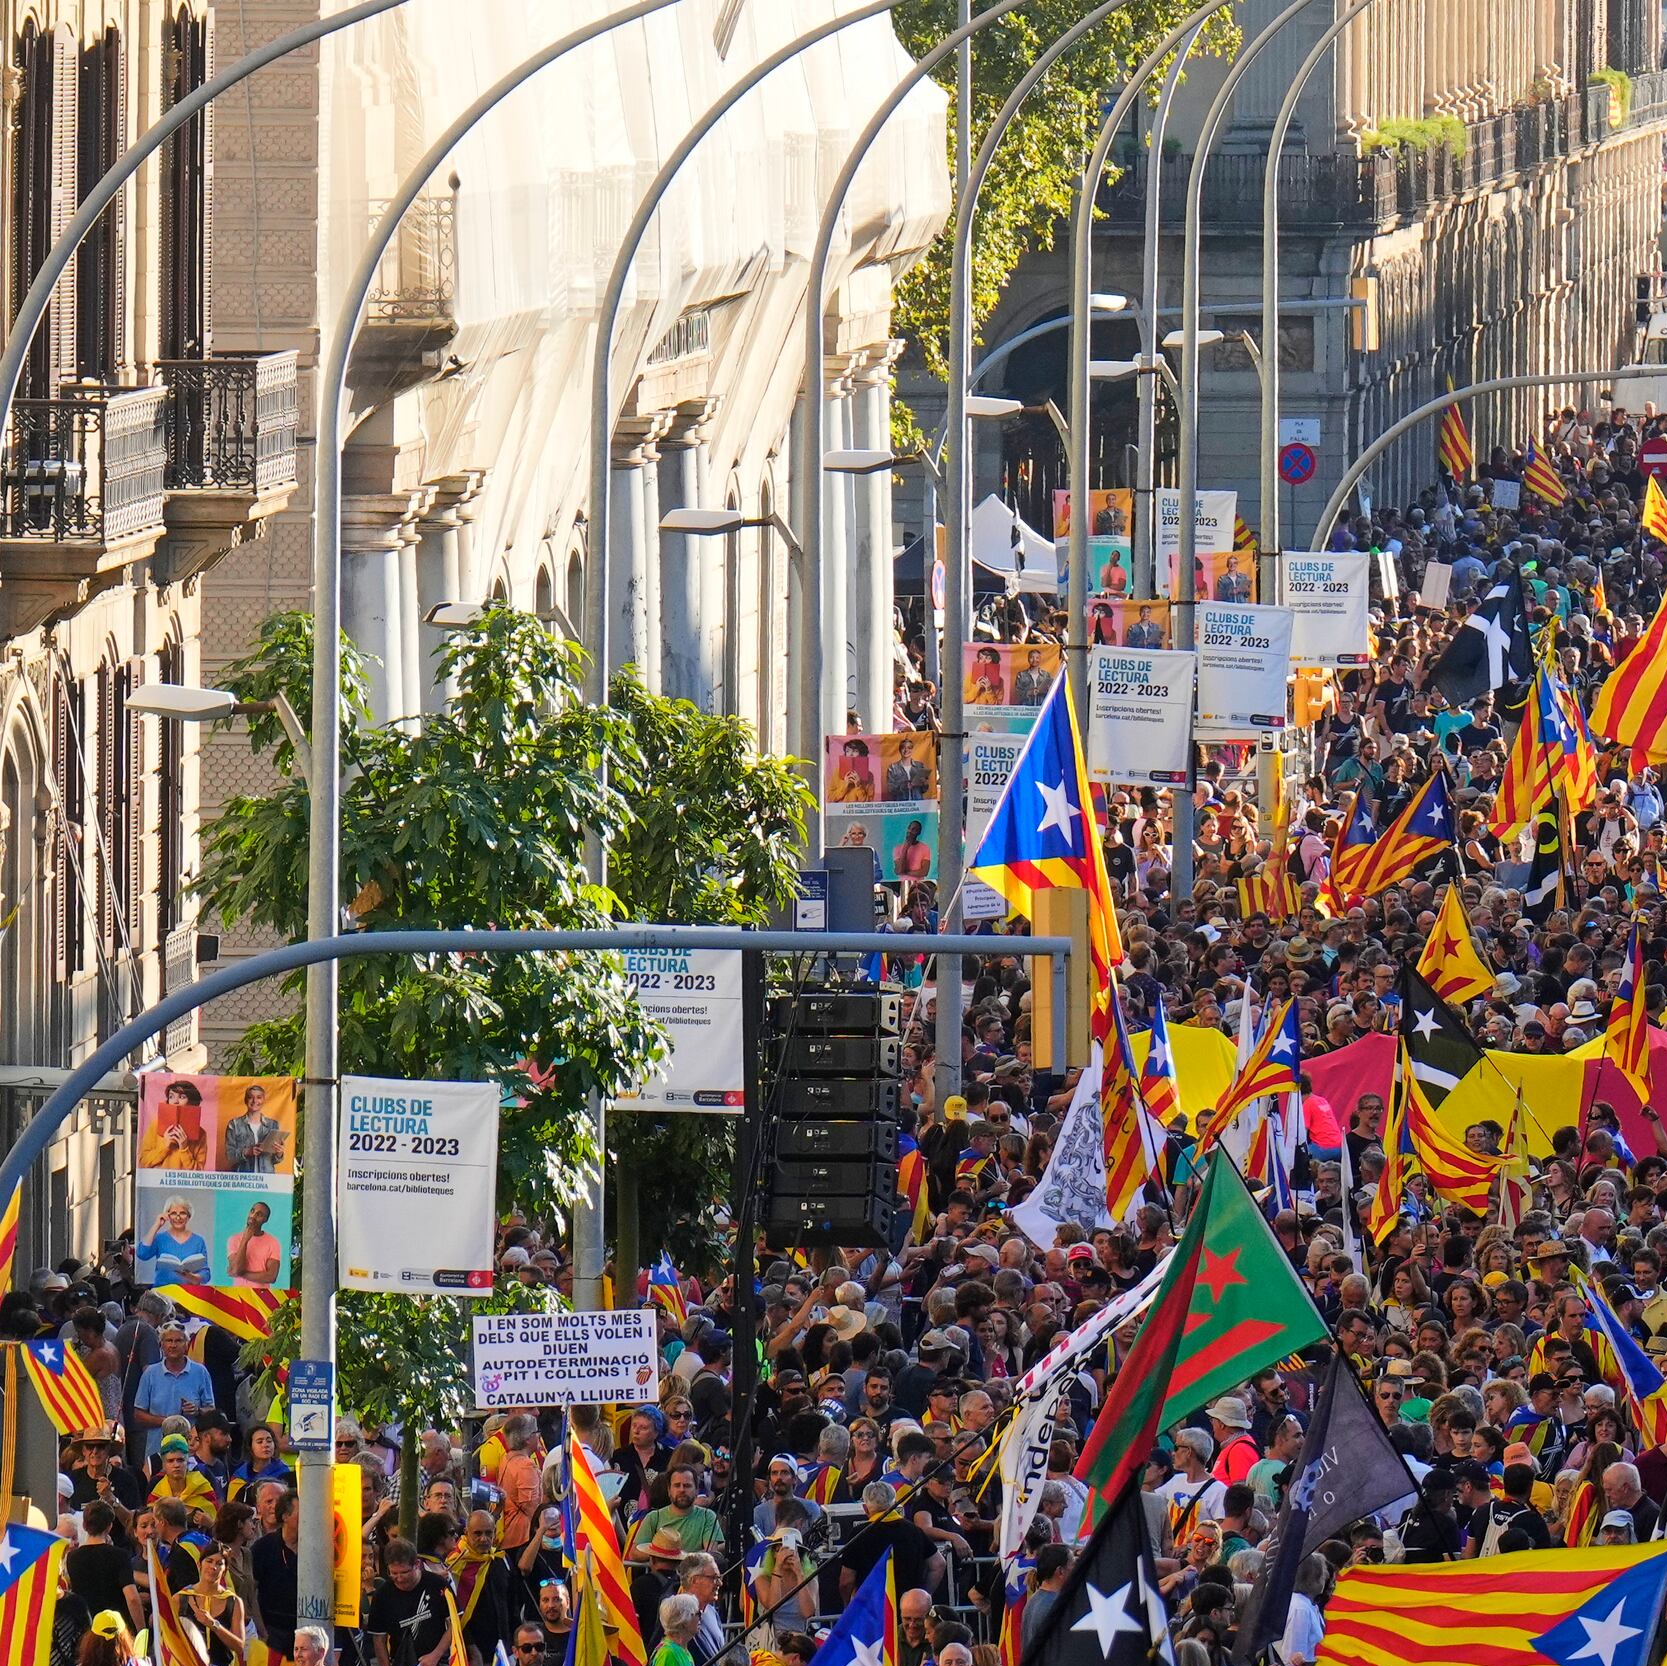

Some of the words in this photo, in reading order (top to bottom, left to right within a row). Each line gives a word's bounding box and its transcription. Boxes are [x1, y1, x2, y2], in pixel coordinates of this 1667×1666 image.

[1289, 562, 1320, 571] CLUBS
[1322, 563, 1334, 571] DE
[1289, 572, 1332, 581] LECTURA
[1289, 582, 1315, 592] 2022
[1323, 583, 1349, 593] 2023
[1206, 612, 1239, 624] CLUBS
[1241, 615, 1255, 625] DE
[1205, 624, 1252, 636] LECTURA
[1204, 634, 1232, 645] 2022
[1240, 637, 1269, 648] 2023
[1099, 657, 1135, 671] CLUBS
[1137, 661, 1152, 672] DE
[1098, 670, 1149, 683] LECTURA
[1097, 682, 1128, 695] 2022
[1137, 684, 1169, 697] 2023
[975, 746, 1014, 759] CLUBS
[974, 773, 1007, 785] 2022
[674, 975, 715, 991] 2023
[672, 1006, 708, 1015] obertes!
[351, 1096, 406, 1116] CLUBS
[411, 1099, 433, 1116] DE
[350, 1115, 429, 1135] LECTURA
[350, 1133, 397, 1152] 2022
[411, 1137, 460, 1156] 2023
[205, 1172, 239, 1181] HISTÒRIES
[348, 1169, 407, 1181] Inscripcions
[410, 1172, 450, 1183] obertes!
[177, 1180, 222, 1188] BIBLIOTEQUES
[232, 1181, 268, 1189] BARCELONA
[347, 1183, 454, 1196] barcelona.cat/biblioteques
[488, 1319, 492, 1330] I
[497, 1319, 516, 1330] EN
[521, 1317, 551, 1329] SOM
[558, 1315, 606, 1327] MOLTS
[611, 1311, 641, 1326] MÉS
[478, 1331, 514, 1344] DELS
[520, 1331, 550, 1343] QUE
[555, 1329, 590, 1341] ELLS
[594, 1327, 642, 1340] VOLEN
[648, 1326, 652, 1337] I
[543, 1343, 588, 1356] DIUEN
[482, 1352, 649, 1371] AUTODETERMINACIÓ
[504, 1370, 528, 1381] PIT
[534, 1369, 538, 1379] I
[544, 1367, 619, 1379] COLLONS
[486, 1391, 575, 1405] CATALUNYA
[581, 1388, 634, 1401] LLIURE
